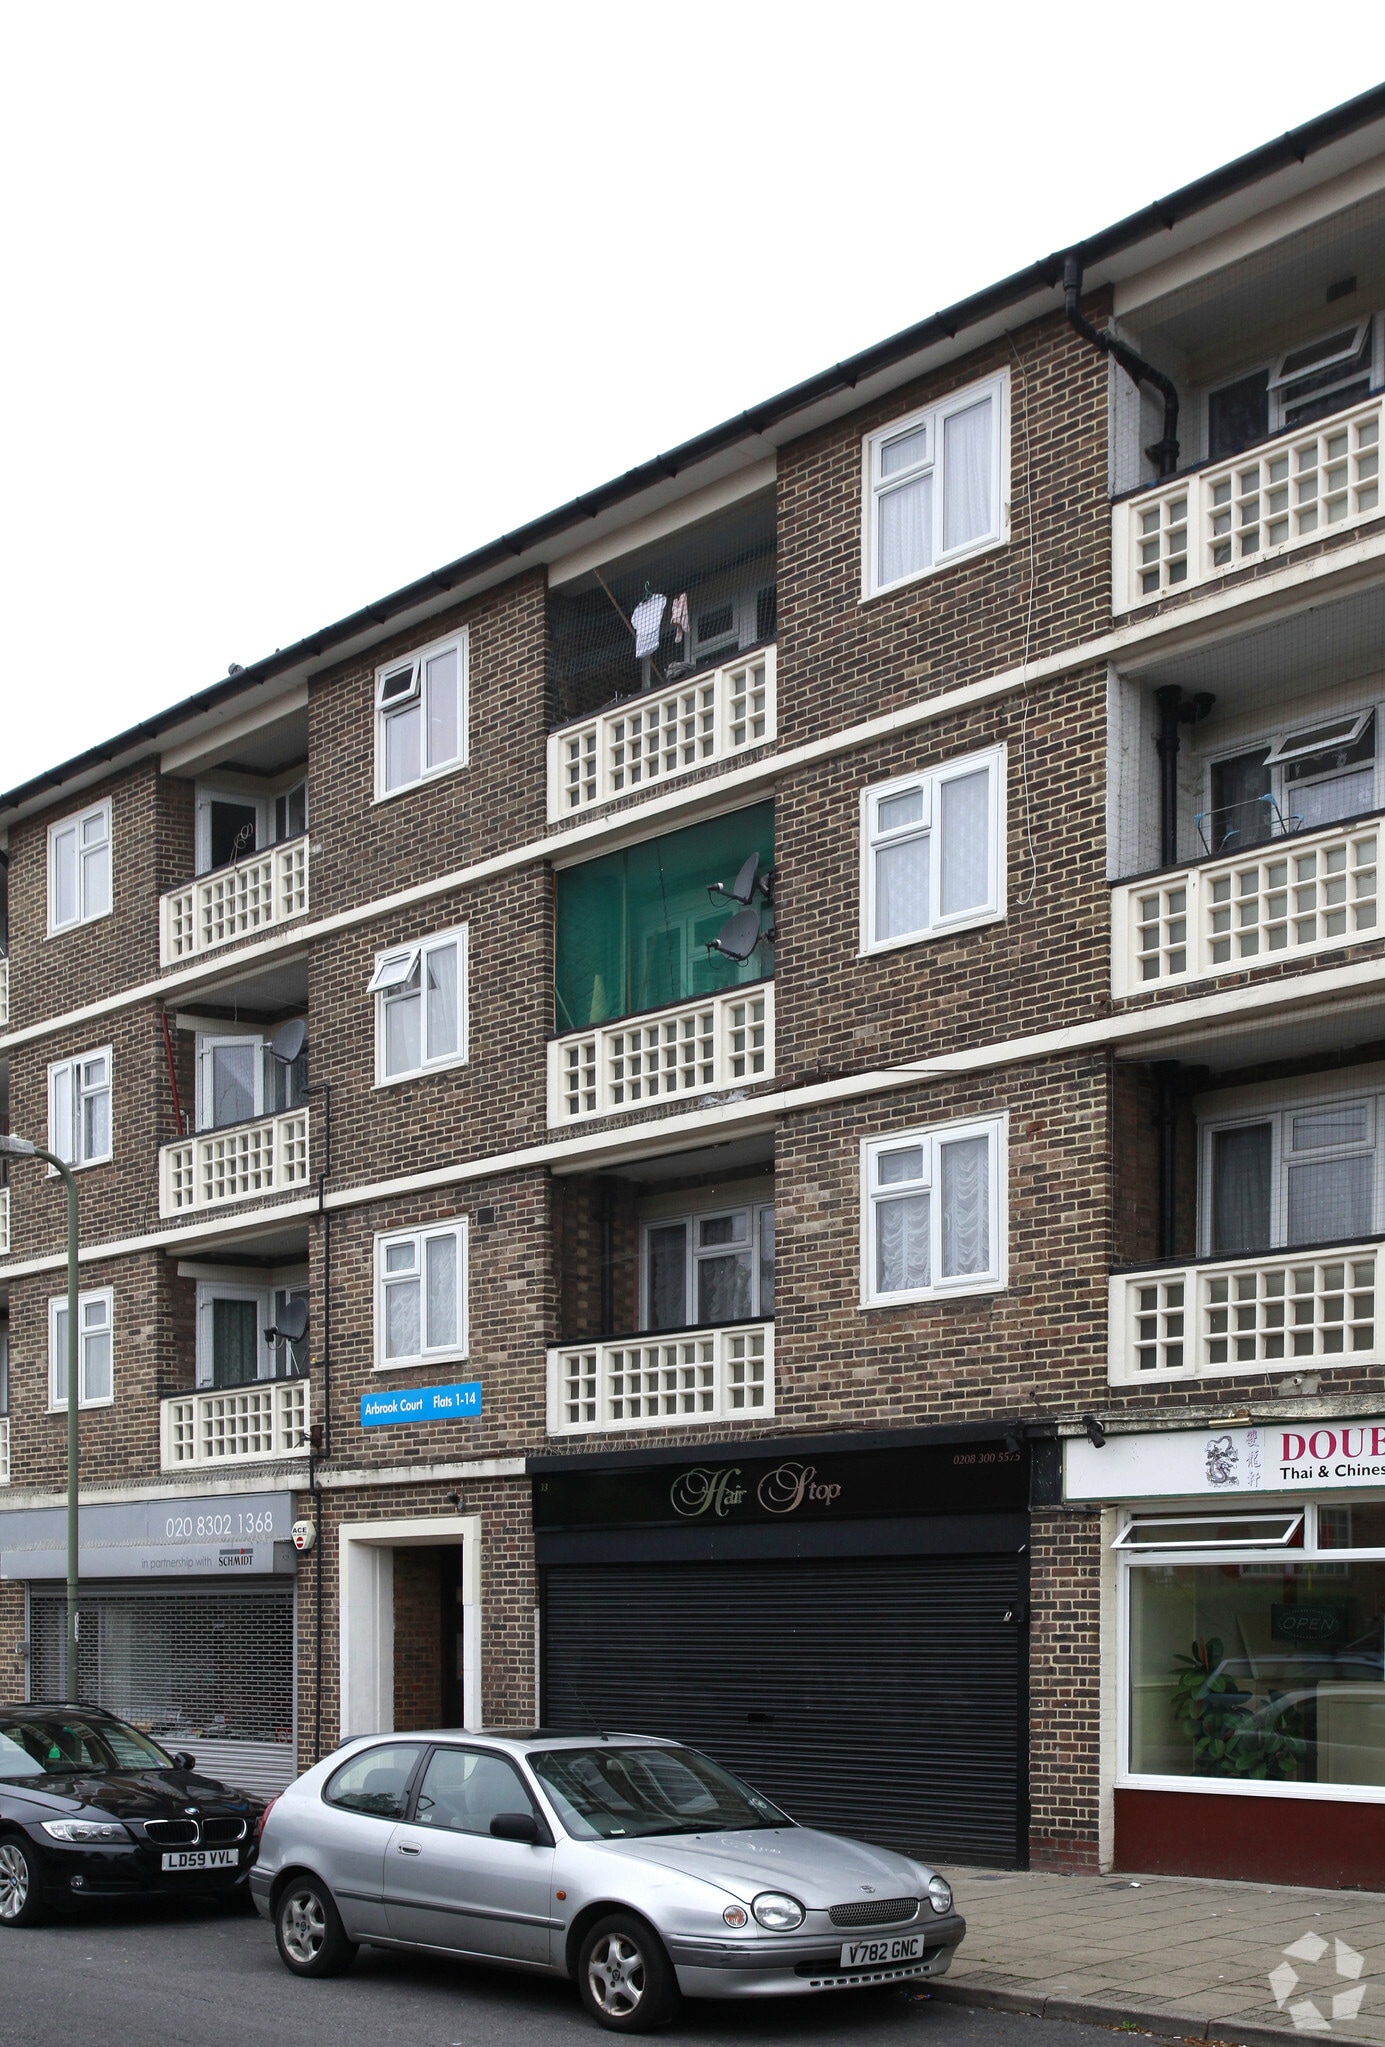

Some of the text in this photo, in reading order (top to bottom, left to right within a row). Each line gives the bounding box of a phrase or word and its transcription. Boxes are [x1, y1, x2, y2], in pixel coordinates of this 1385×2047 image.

[364, 1391, 476, 1416] Arbrook Court Flats 1-14
[1279, 1426, 1385, 1462] DOUB
[953, 1454, 976, 1465] 0208
[978, 1452, 996, 1464] 300
[1279, 1463, 1385, 1480] Thai & Chines
[670, 1461, 842, 1517] Hair Stop
[165, 1511, 273, 1538] 020 8302 1368
[292, 1526, 308, 1534] ACE
[142, 1555, 212, 1570] in partnership with
[218, 1555, 254, 1567] SCHMIDT
[1282, 1617, 1336, 1631] OPEN
[168, 1851, 233, 1868] LD59 VVL
[849, 1938, 919, 1964] V782 GNC
